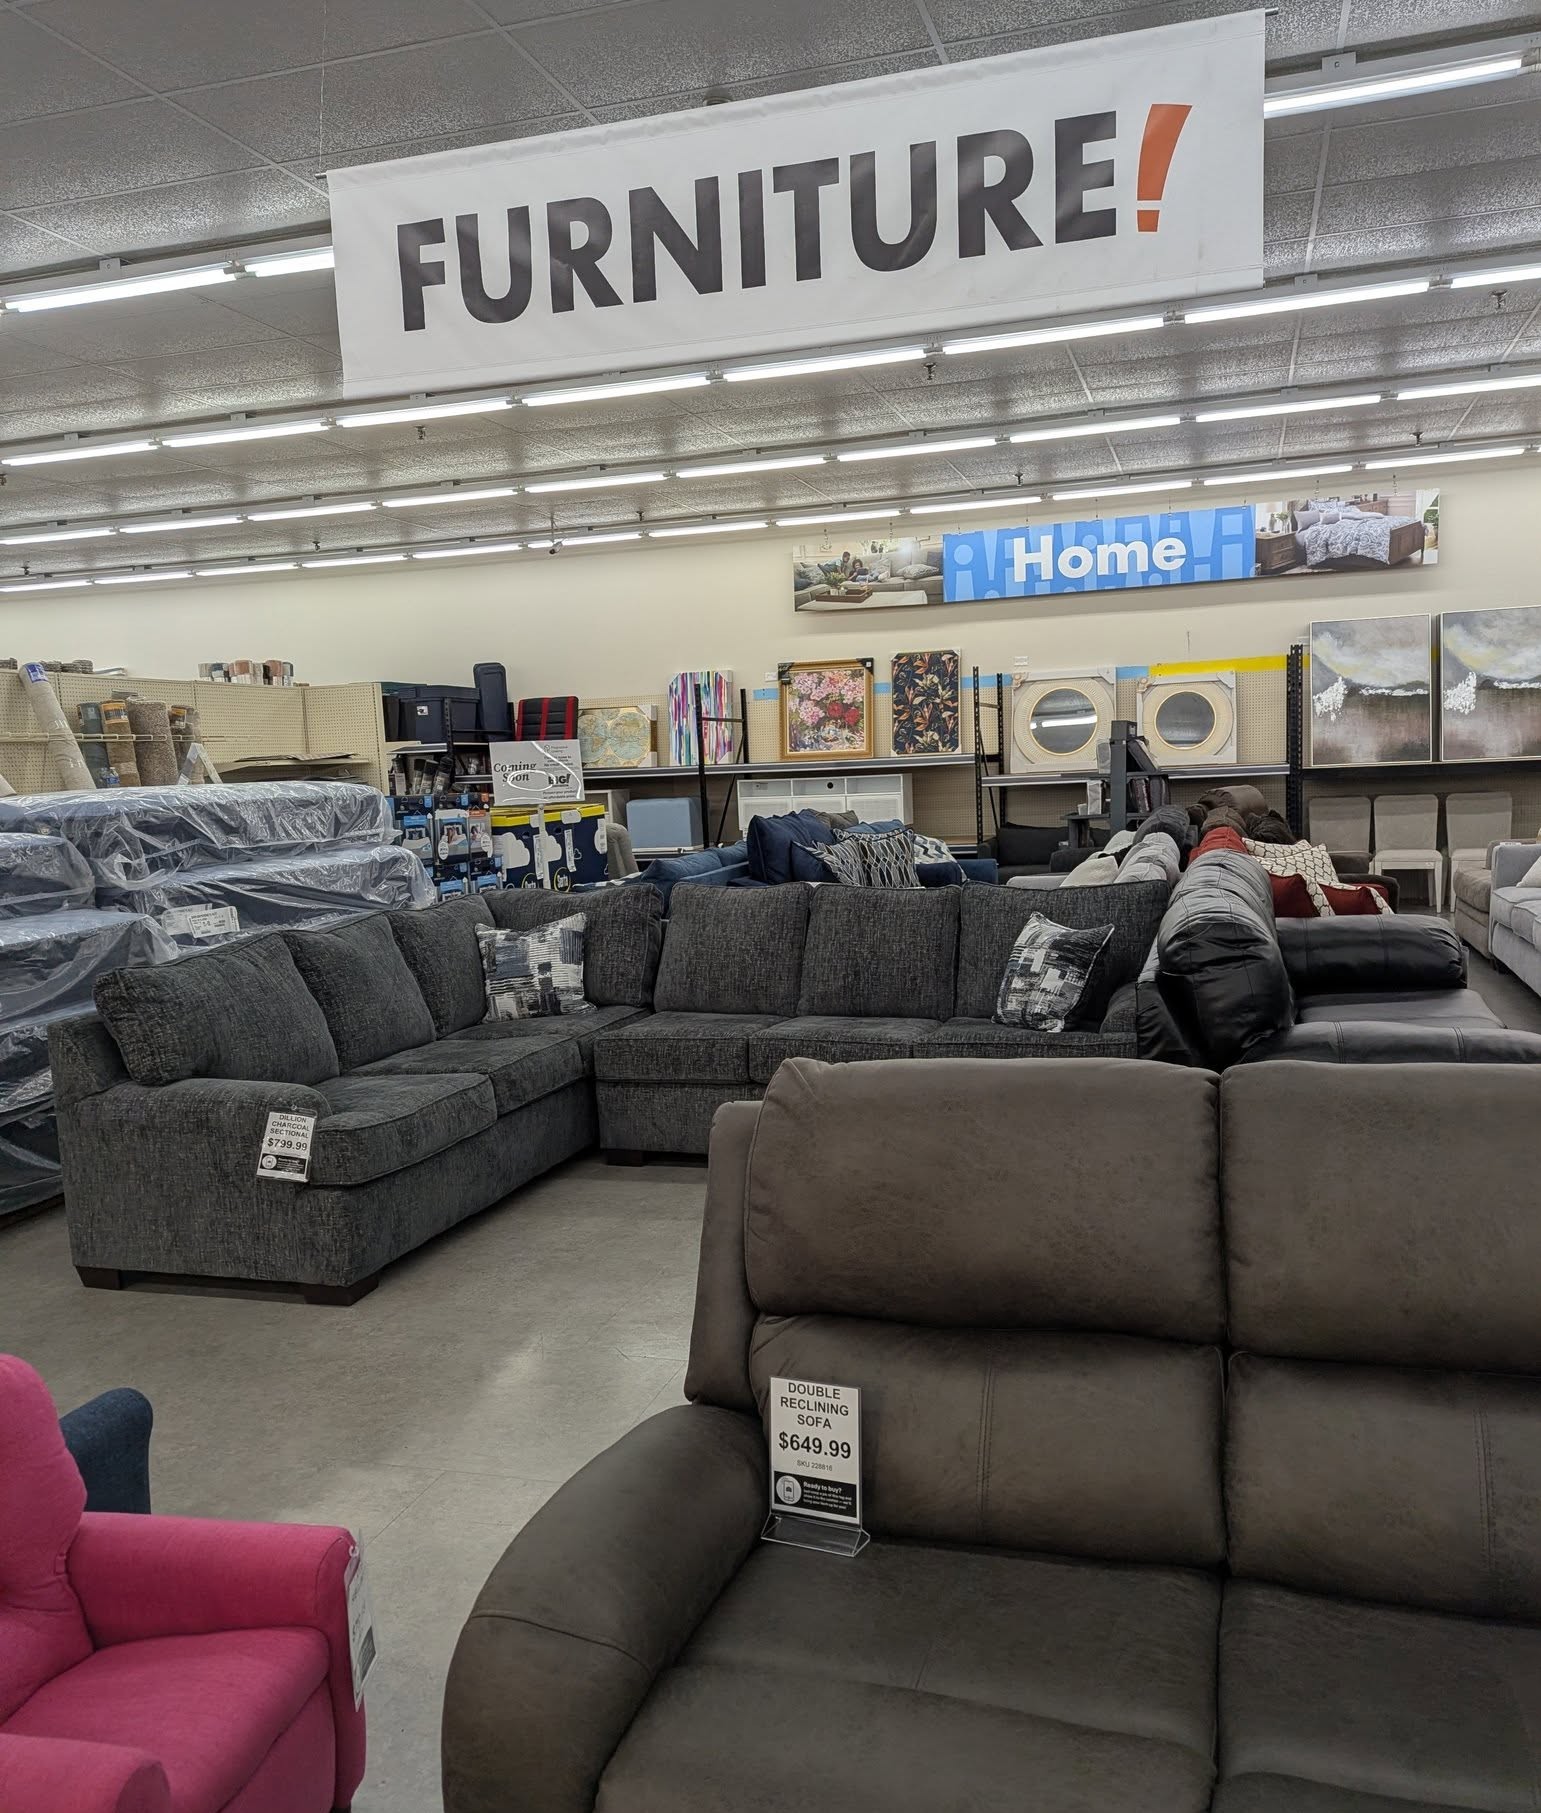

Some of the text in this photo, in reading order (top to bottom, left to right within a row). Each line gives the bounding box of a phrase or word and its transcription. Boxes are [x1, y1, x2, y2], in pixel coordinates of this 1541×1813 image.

[397, 103, 1193, 332] FURNITURE!
[1013, 534, 1187, 583] Home
[279, 1114, 307, 1123] DILLION
[271, 1120, 310, 1132] CHARCOAL
[269, 1128, 309, 1139] SECTIONAL
[267, 1137, 308, 1151] $799.99
[788, 1382, 841, 1400] DOUBLE
[780, 1396, 849, 1416] RECLINING
[797, 1414, 832, 1429] SOFA
[778, 1431, 851, 1459] $649.99
[796, 1459, 810, 1468] SKU
[803, 1481, 821, 1490] Ready
[828, 1486, 842, 1494] buy?
